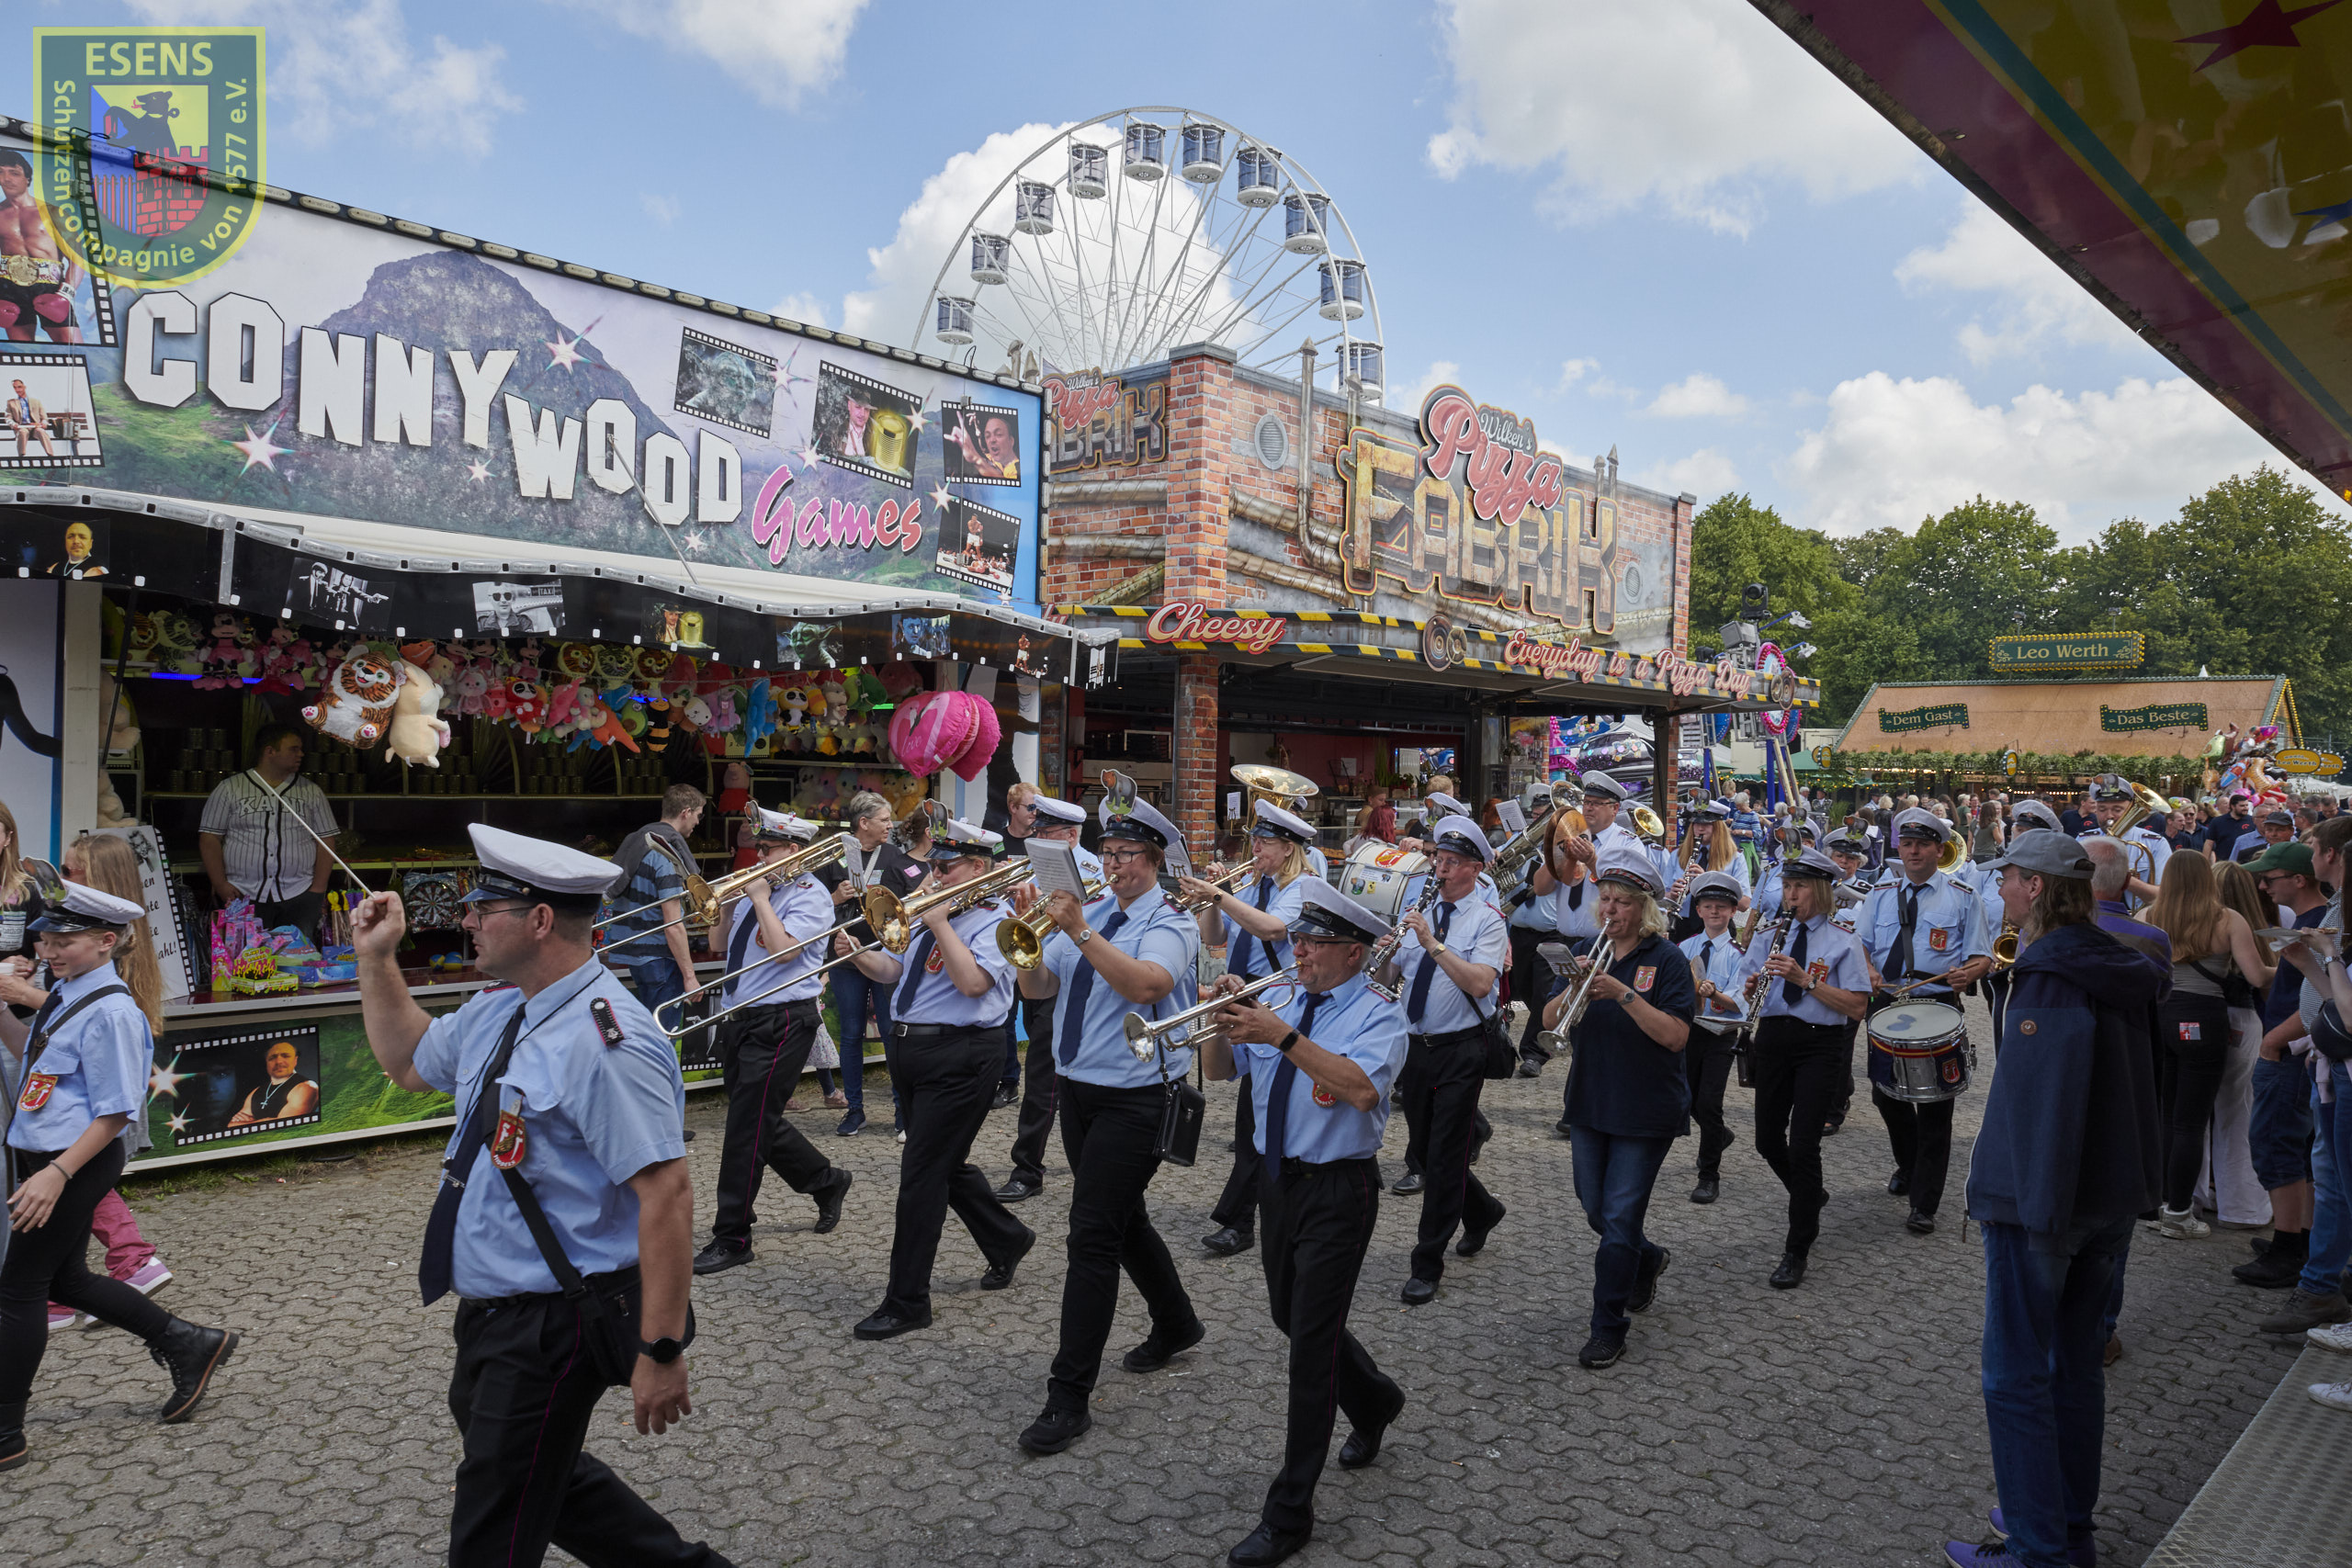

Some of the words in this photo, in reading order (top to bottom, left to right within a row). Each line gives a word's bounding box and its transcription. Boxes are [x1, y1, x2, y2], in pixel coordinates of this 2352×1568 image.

[1041, 378, 1119, 430] Pizza
[1480, 412, 1532, 450] Wilken's
[1427, 394, 1562, 526] Pizza
[752, 464, 922, 567] Games
[1351, 438, 1615, 617] FABRIK
[1147, 601, 1286, 654] Cheesy
[2017, 646, 2050, 660] Leo
[2056, 643, 2109, 658] Werth
[1504, 629, 1601, 683] Everyday
[1608, 650, 1627, 677] is
[1634, 659, 1649, 680] a
[1655, 648, 1709, 697] Pizza
[1713, 659, 1750, 701] Day
[1893, 716, 1921, 726] Dem
[1925, 710, 1953, 722] Gast
[2117, 715, 2144, 725] Das
[2149, 710, 2189, 723] Beste
[158, 941, 177, 960] ahl!
